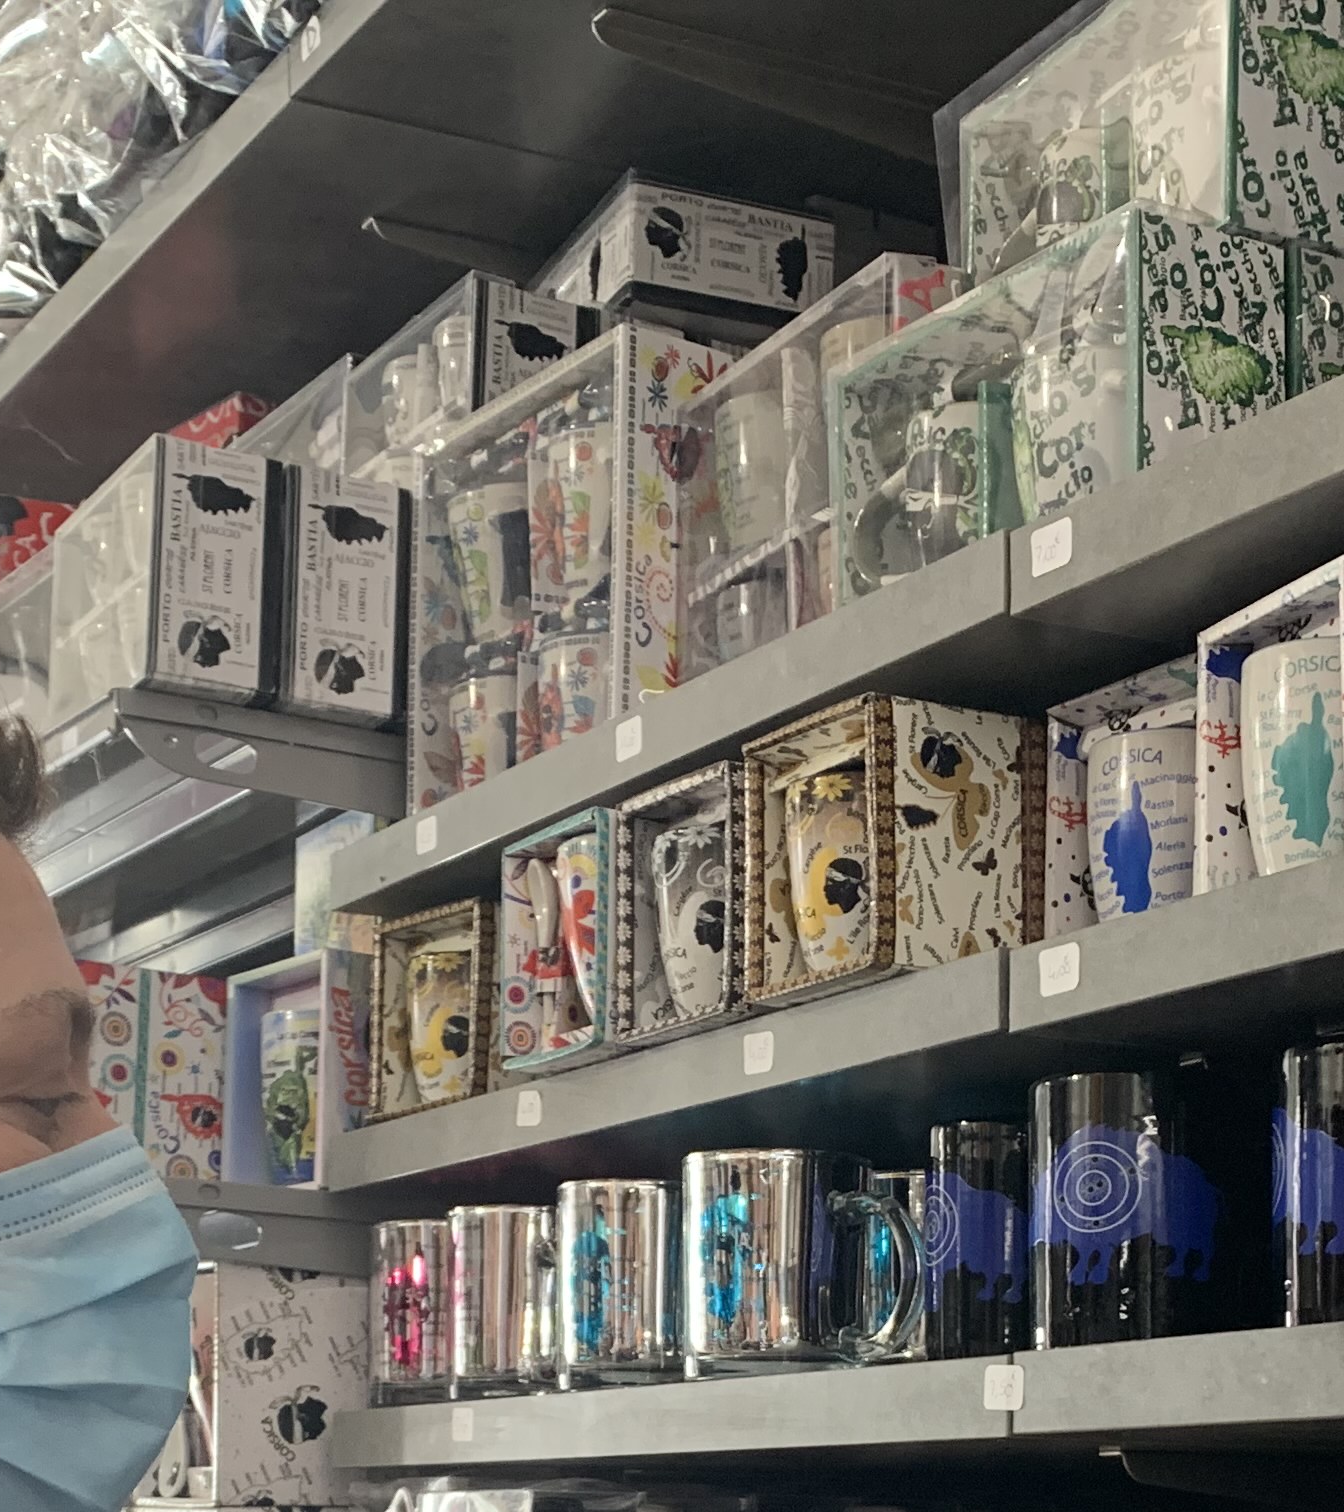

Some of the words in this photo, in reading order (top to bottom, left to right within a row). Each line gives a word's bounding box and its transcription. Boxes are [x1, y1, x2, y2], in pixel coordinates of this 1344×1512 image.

[662, 192, 704, 207] PORTO
[747, 214, 793, 233] BASTIA
[491, 333, 506, 387] BASTIA
[171, 489, 183, 541] BASTIA
[306, 519, 318, 571] BASTIA
[223, 549, 233, 594] CORSICA
[162, 593, 173, 643] PORTO
[358, 577, 368, 622] CORSICA
[299, 622, 308, 671] PORTO
[956, 788, 969, 838] CORSICA
[260, 1416, 297, 1462] CORSICA
